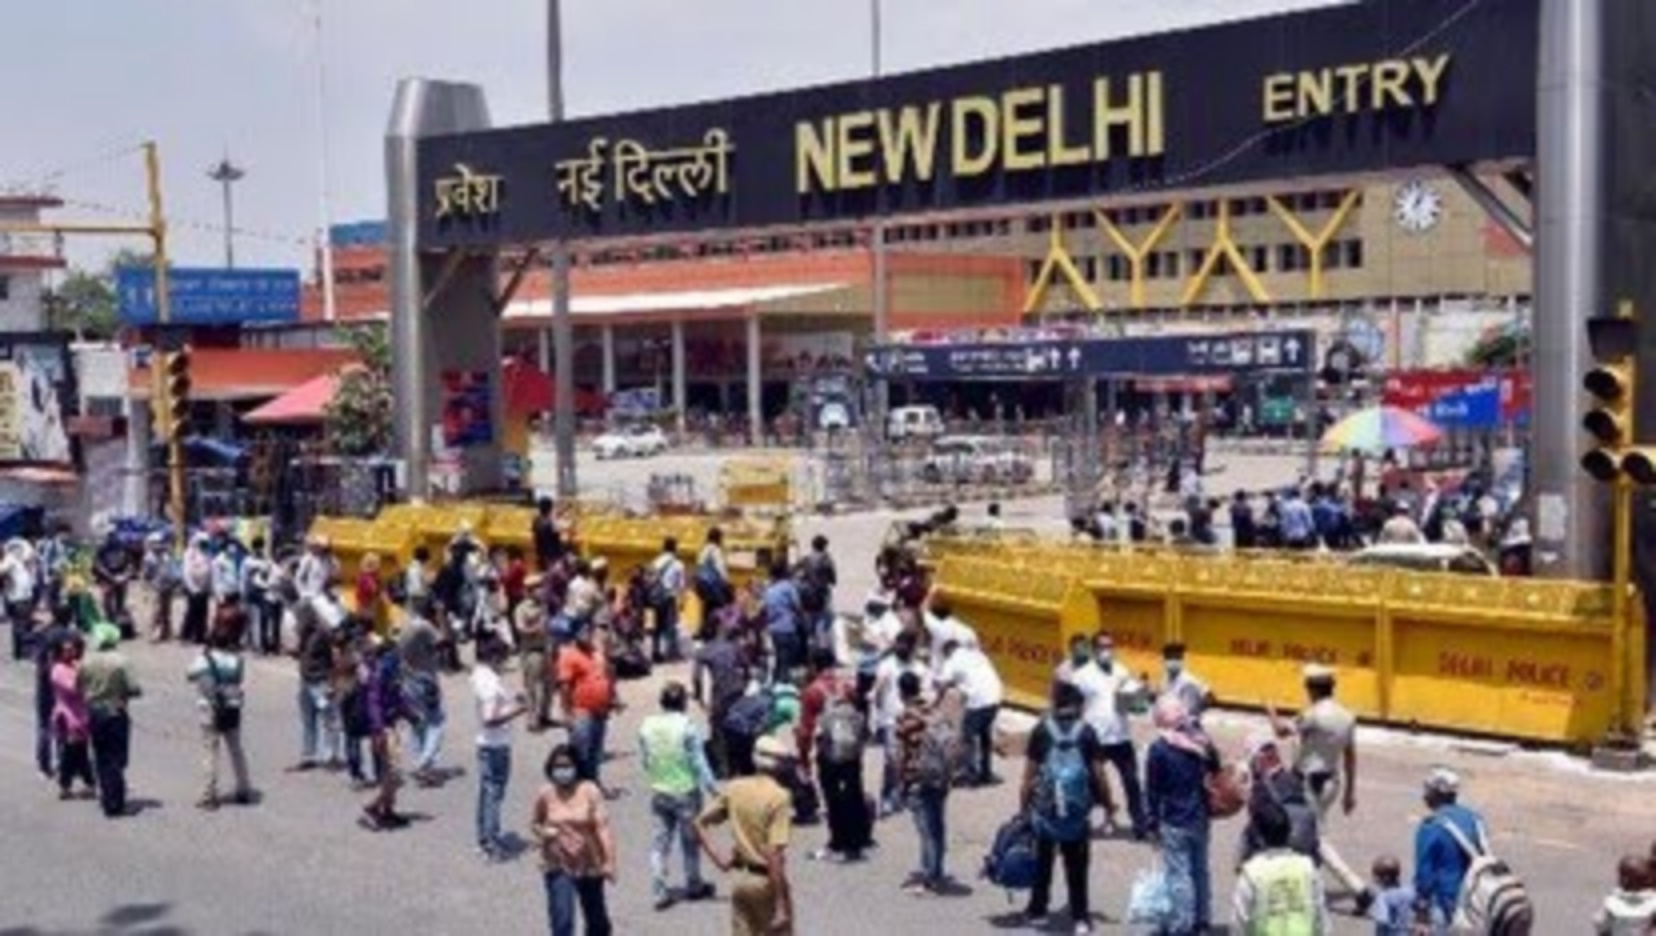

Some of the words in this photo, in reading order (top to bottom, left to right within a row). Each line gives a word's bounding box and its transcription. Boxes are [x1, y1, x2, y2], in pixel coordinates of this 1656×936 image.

[1264, 54, 1449, 121] ENTRY
[796, 103, 941, 193] NEW
[952, 71, 1164, 176] DELHI
[435, 163, 502, 217] प्रवेश
[555, 138, 606, 211] नई
[613, 129, 735, 203] दिल्ली
[1439, 652, 1493, 676] DELHI
[1507, 659, 1569, 688] POLICE
